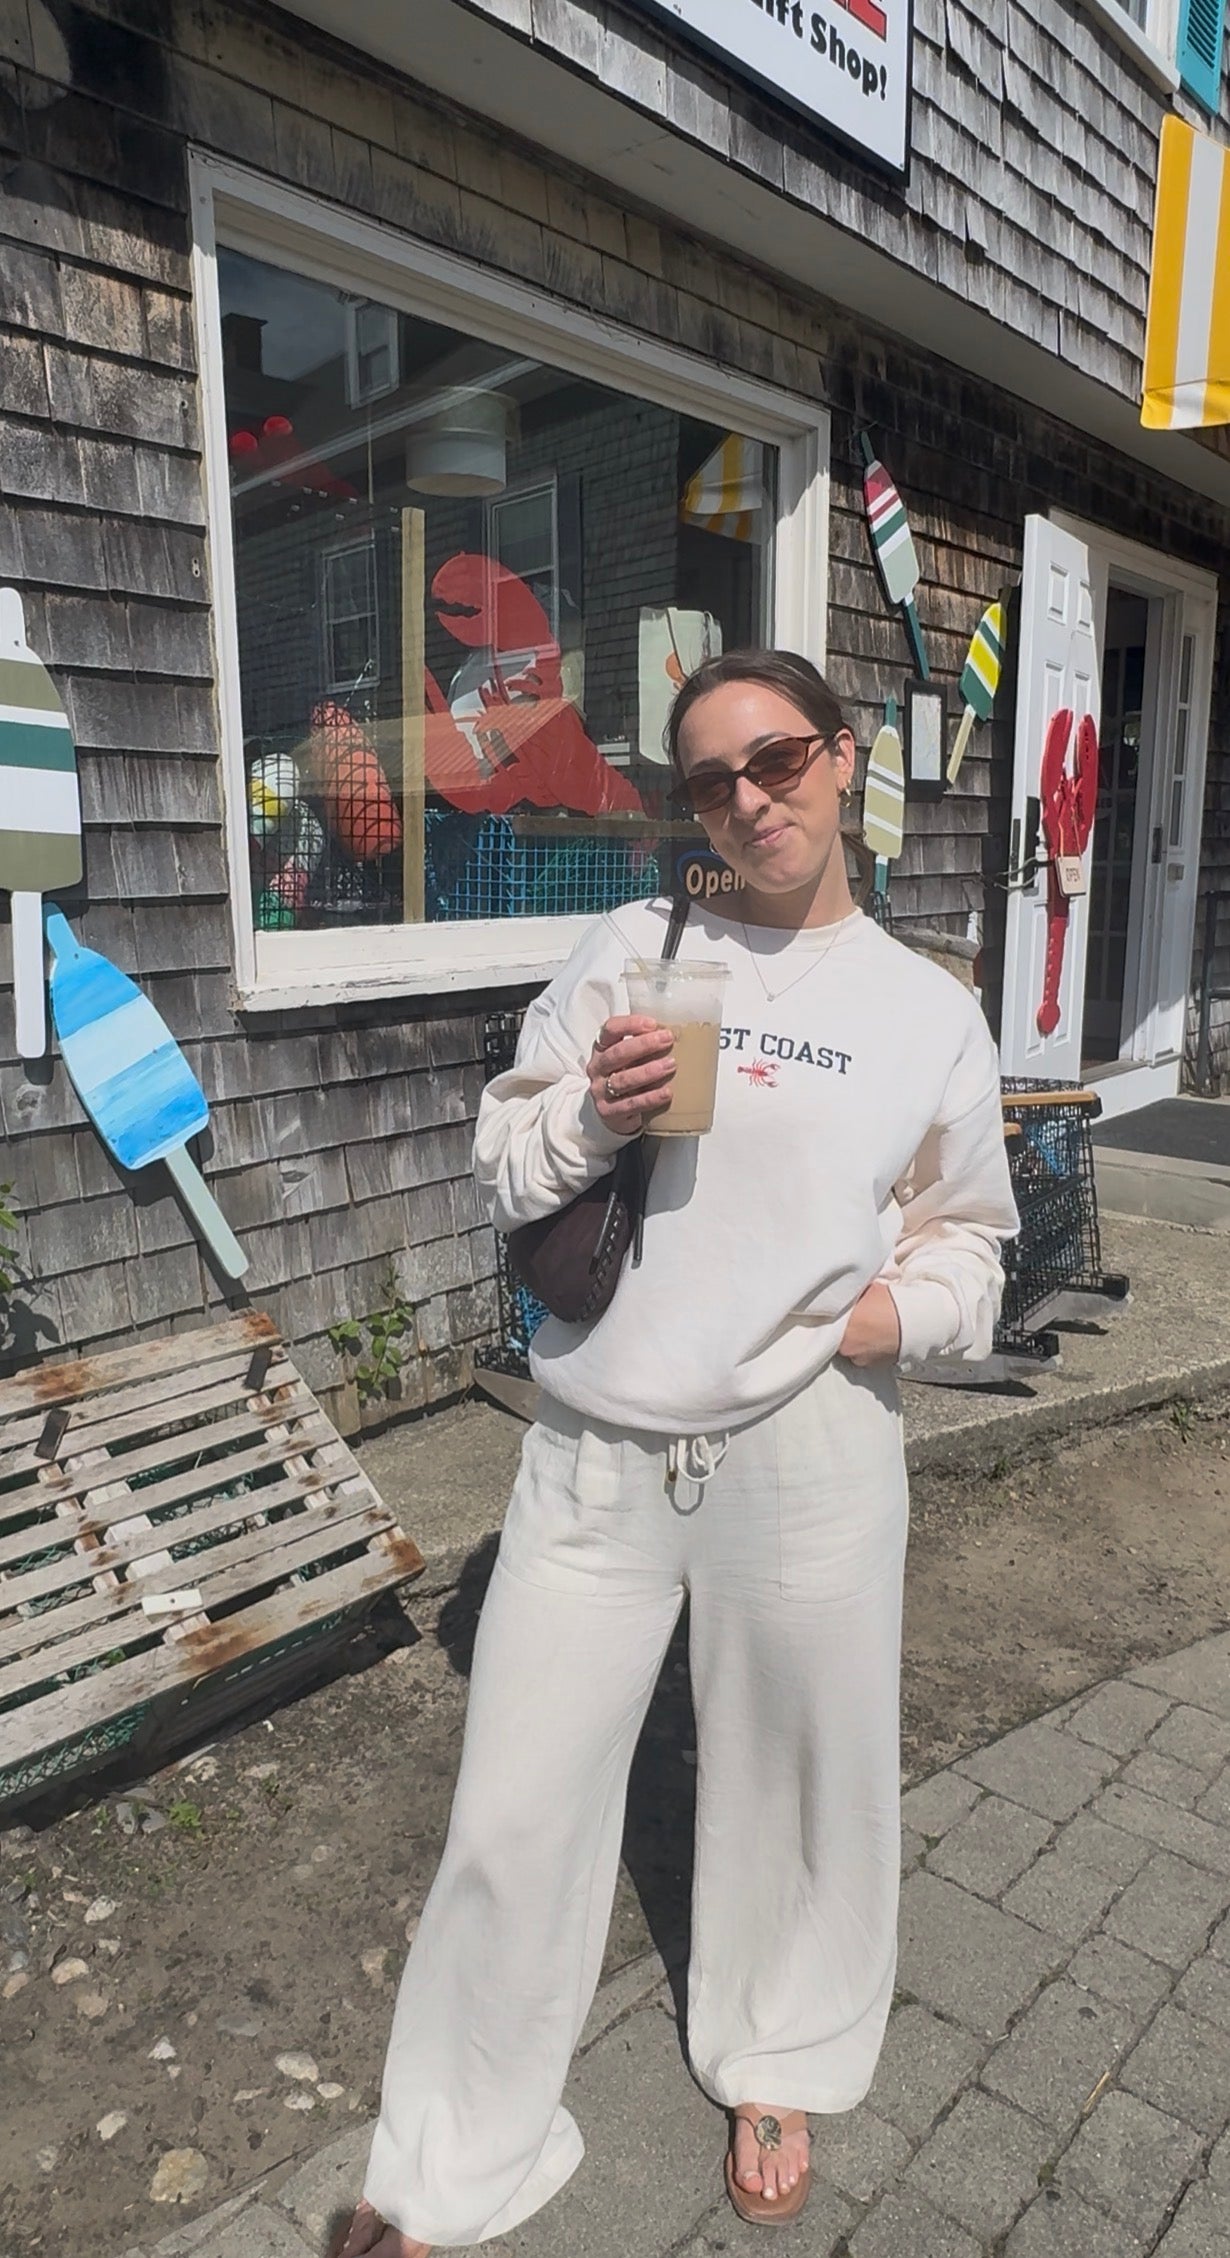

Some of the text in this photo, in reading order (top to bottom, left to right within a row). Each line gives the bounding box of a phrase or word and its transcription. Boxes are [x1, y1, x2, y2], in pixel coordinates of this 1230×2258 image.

[810, 12, 887, 101] Shop!
[719, 1028, 852, 1075] ST COAST
